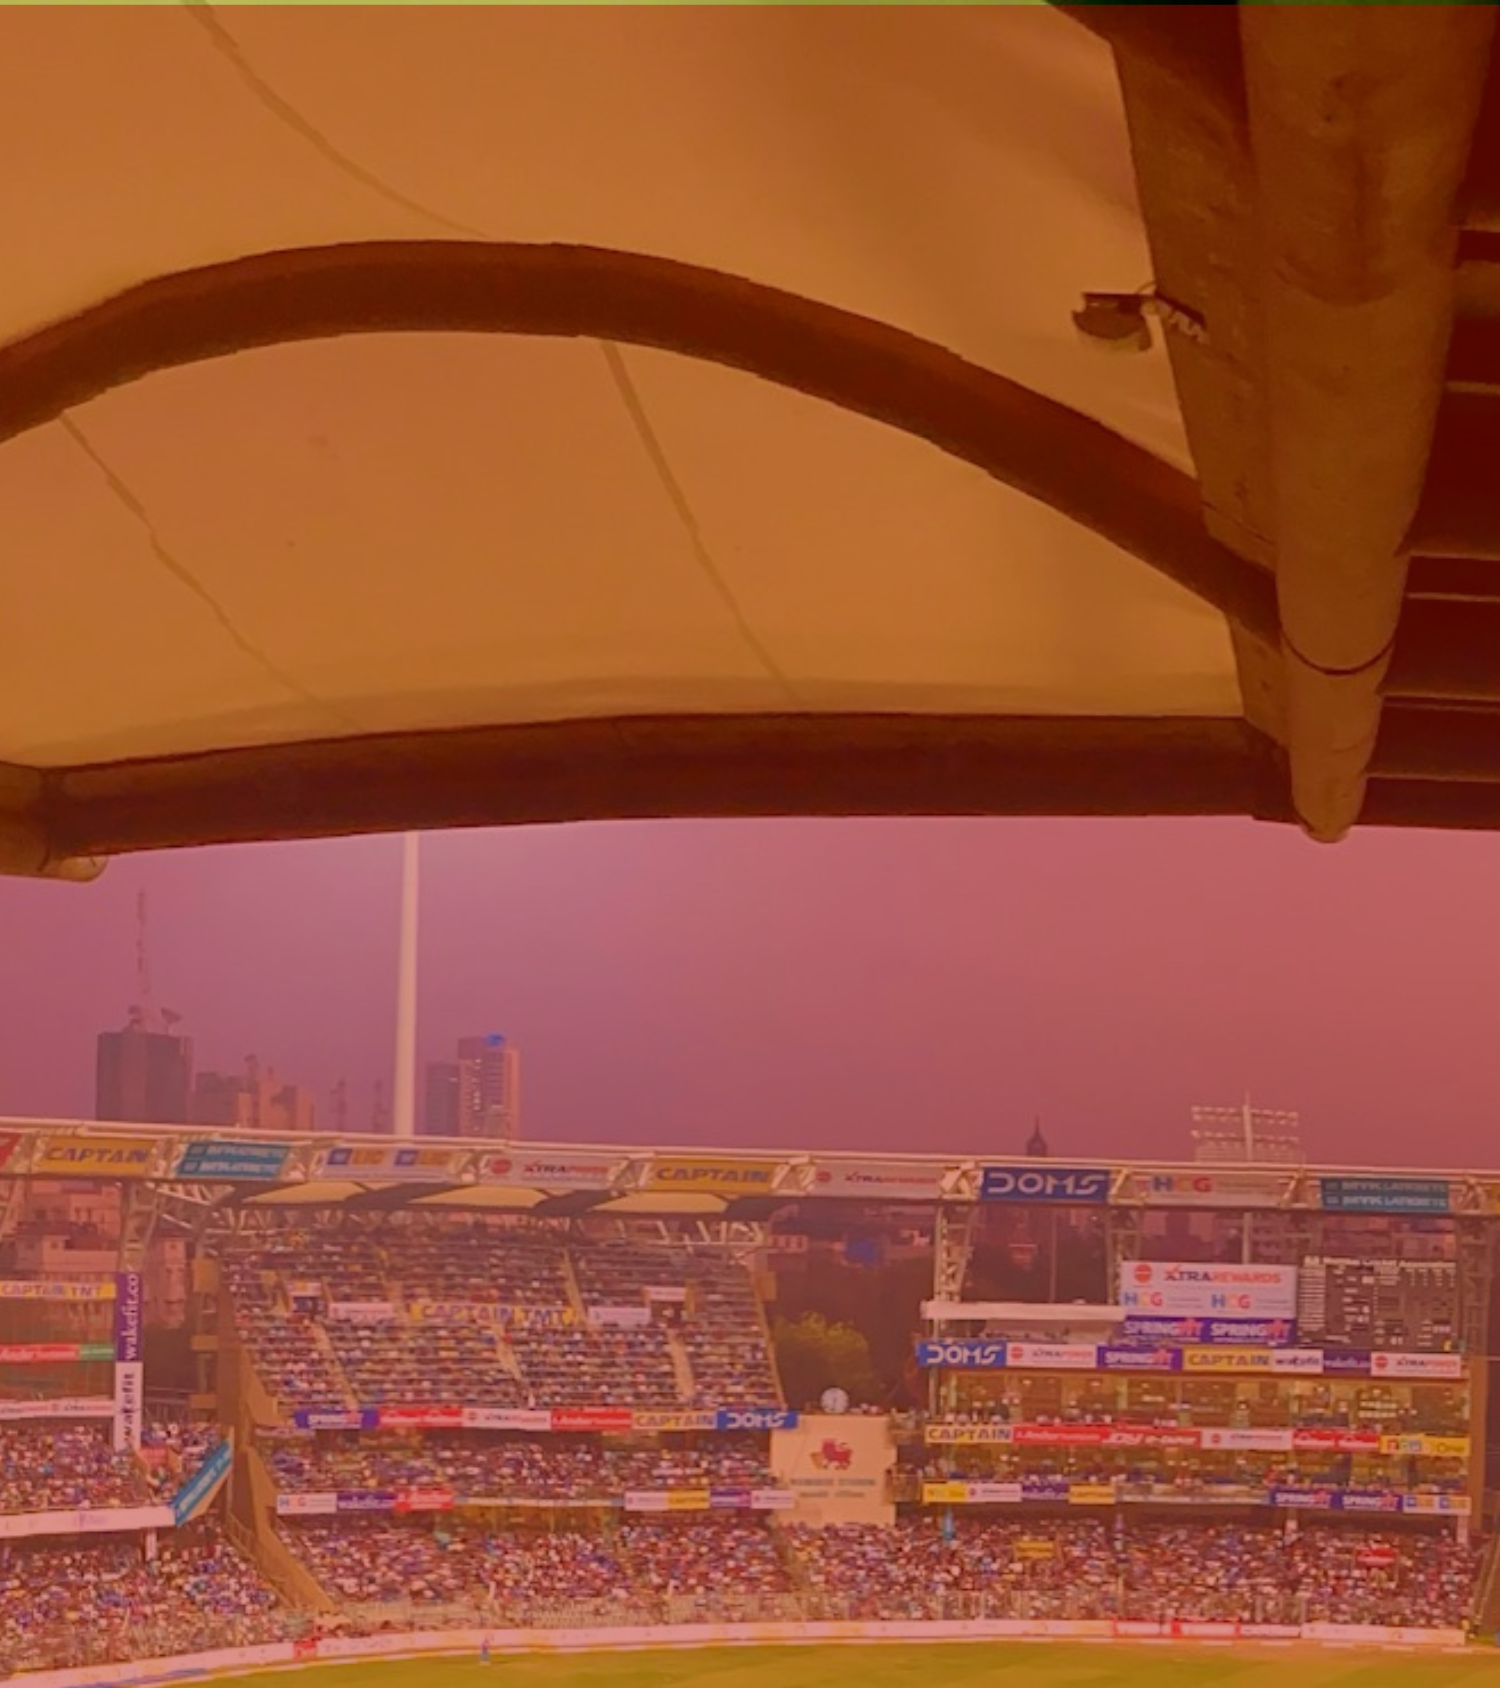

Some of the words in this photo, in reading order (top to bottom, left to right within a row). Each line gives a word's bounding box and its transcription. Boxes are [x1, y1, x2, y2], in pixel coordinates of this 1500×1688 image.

[46, 1144, 148, 1165] CAPTAIN
[656, 1164, 772, 1184] CAPTAIN
[986, 1173, 1107, 1195] DOMS
[1153, 1175, 1213, 1193] HCG
[1164, 1265, 1282, 1284] XTRAREWARDS
[926, 1347, 1002, 1364] DOMS
[1188, 1354, 1269, 1367] CAPTAIN
[636, 1415, 715, 1428] CAPTAIN
[727, 1412, 788, 1428] DOMS
[928, 1427, 1010, 1440] CAPTAIN
